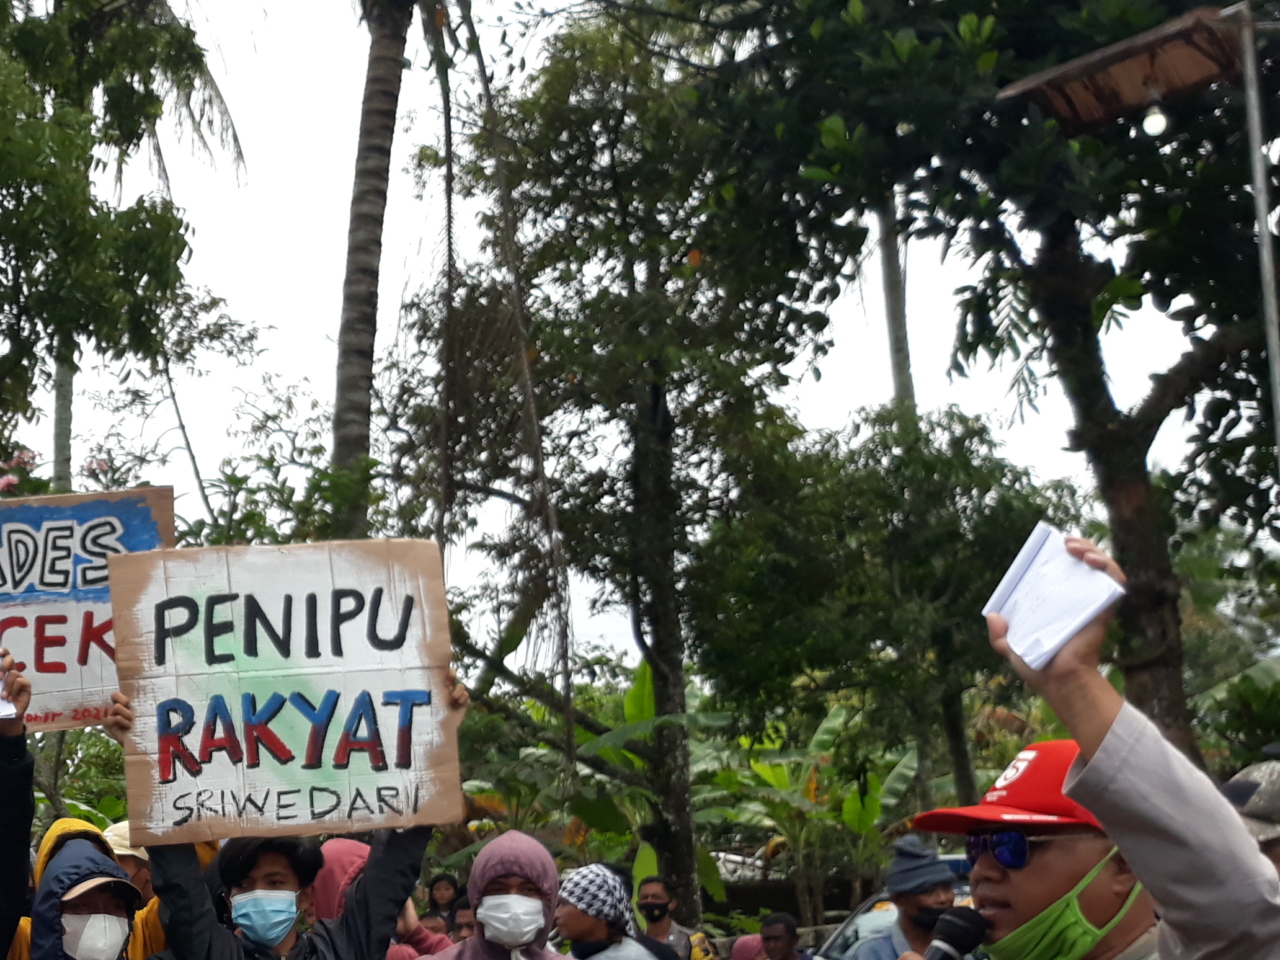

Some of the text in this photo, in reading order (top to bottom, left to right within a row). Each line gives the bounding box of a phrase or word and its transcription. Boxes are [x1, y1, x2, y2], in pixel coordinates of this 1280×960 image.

[154, 587, 415, 666] PENIPU
[156, 689, 432, 784] RAKYAT
[172, 784, 422, 827] SRIWEDARI
